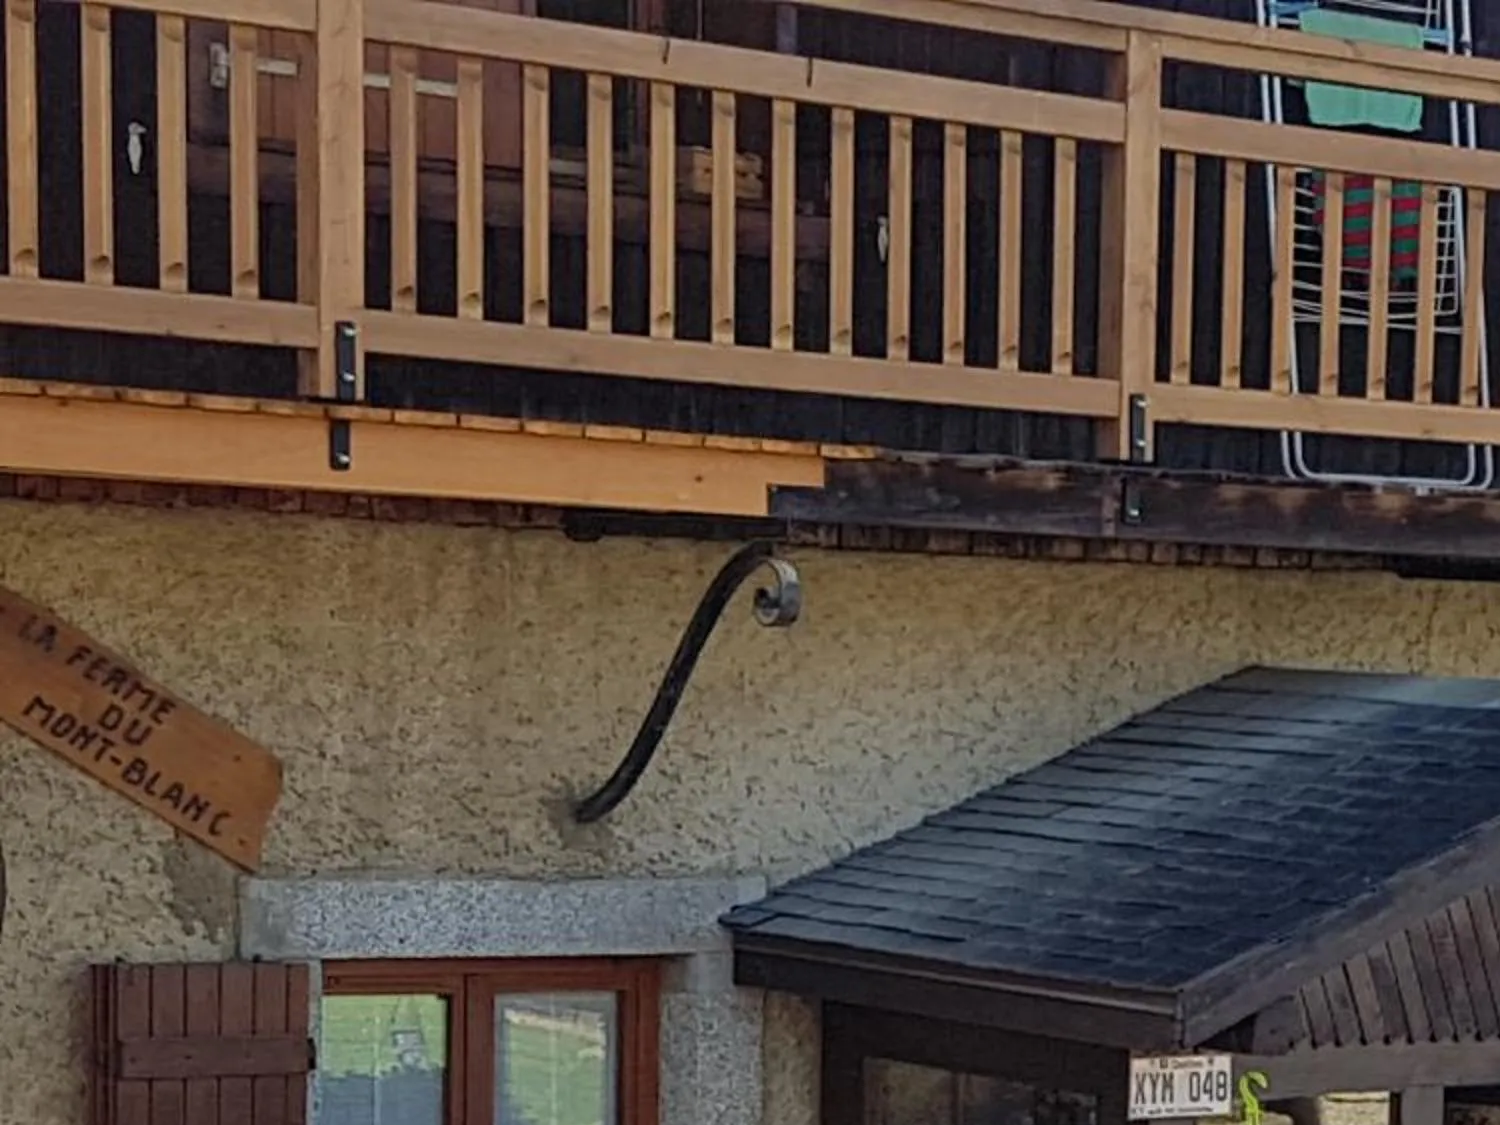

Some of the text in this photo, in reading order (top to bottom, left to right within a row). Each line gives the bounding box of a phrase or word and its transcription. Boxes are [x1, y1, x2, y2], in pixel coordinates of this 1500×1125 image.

[18, 612, 178, 726] LA FERME
[99, 703, 153, 747] DU
[22, 694, 232, 837] MONT-BLANC
[1135, 1069, 1228, 1105] XYM 048
